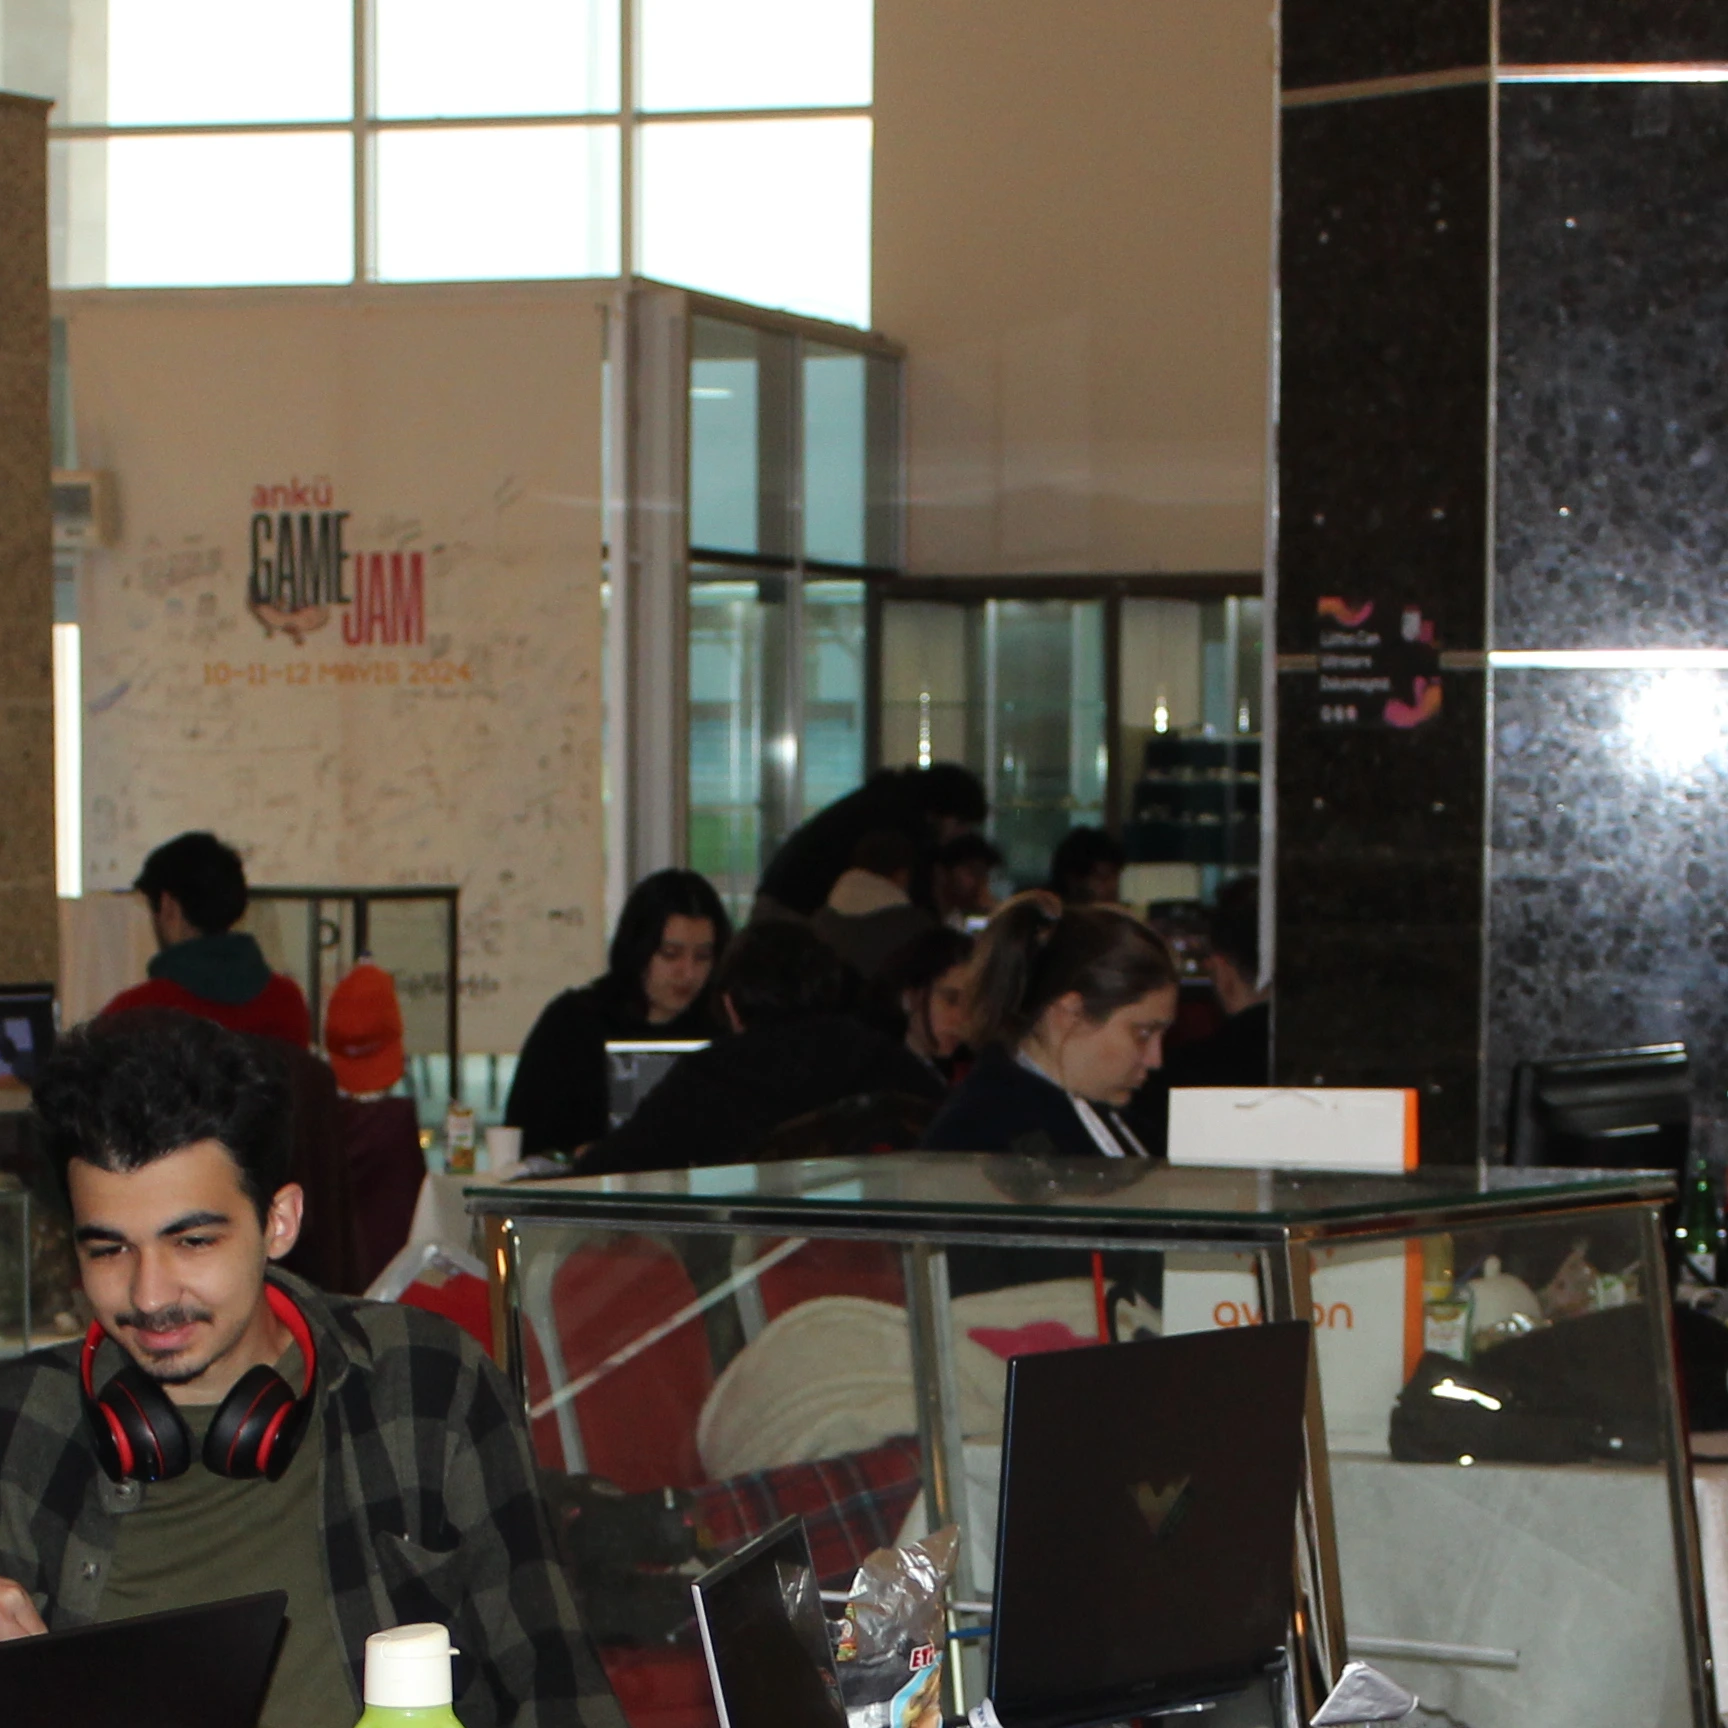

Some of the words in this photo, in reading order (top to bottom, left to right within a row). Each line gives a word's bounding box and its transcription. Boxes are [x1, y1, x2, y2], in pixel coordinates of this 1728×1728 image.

[251, 476, 333, 508] ankü
[250, 511, 351, 605] GAME
[341, 551, 425, 647] JAM
[203, 663, 312, 686] 10-11-12
[408, 662, 473, 686] 2024
